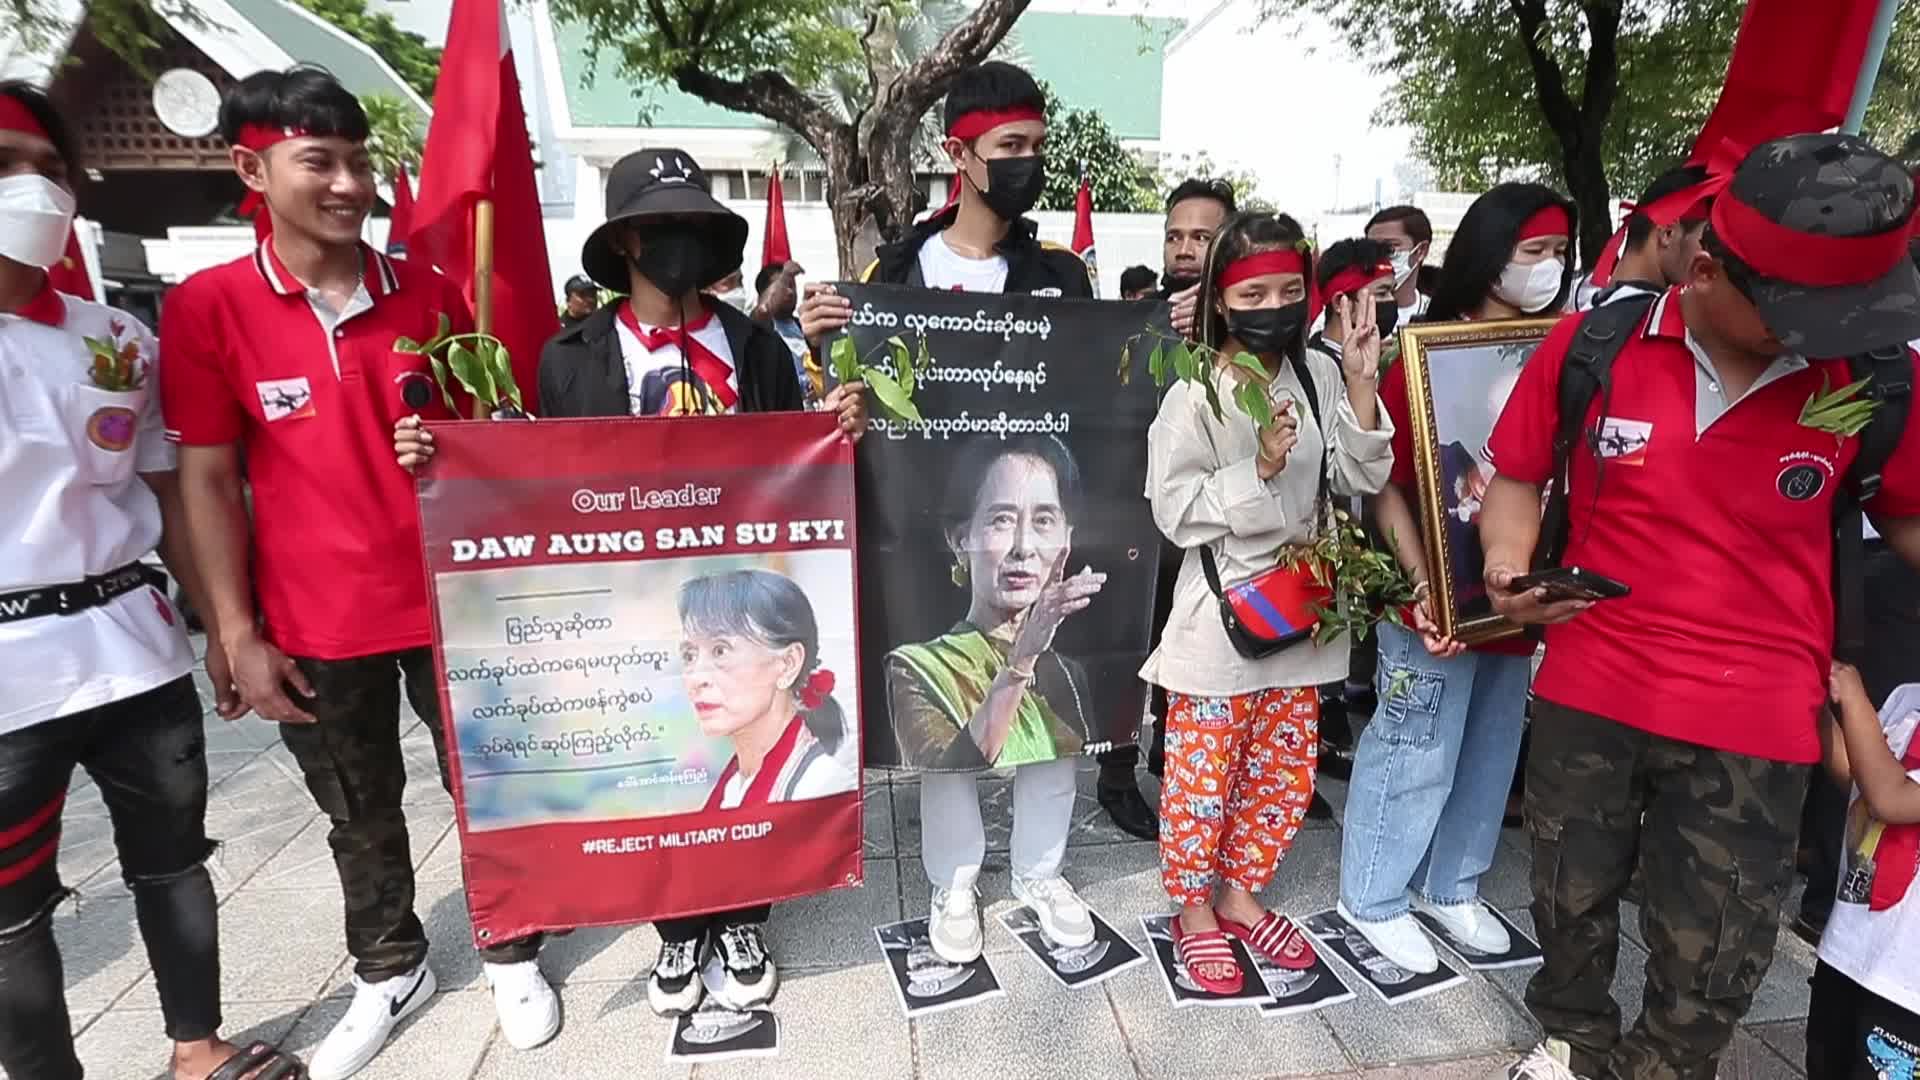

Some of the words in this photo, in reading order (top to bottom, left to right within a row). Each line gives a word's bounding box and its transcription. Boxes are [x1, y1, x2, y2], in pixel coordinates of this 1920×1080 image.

[572, 489, 625, 513] Our
[630, 484, 722, 511] Leader
[451, 535, 535, 561] DAW
[547, 530, 645, 555] AUNG
[656, 525, 724, 549] SAN
[736, 522, 777, 545] SU
[788, 520, 846, 542] KYI
[505, 612, 612, 645] ပြည်သူဆိုတာ
[582, 835, 655, 854] #REJECT
[659, 827, 727, 848] MILITARY
[731, 821, 773, 841] COUP
